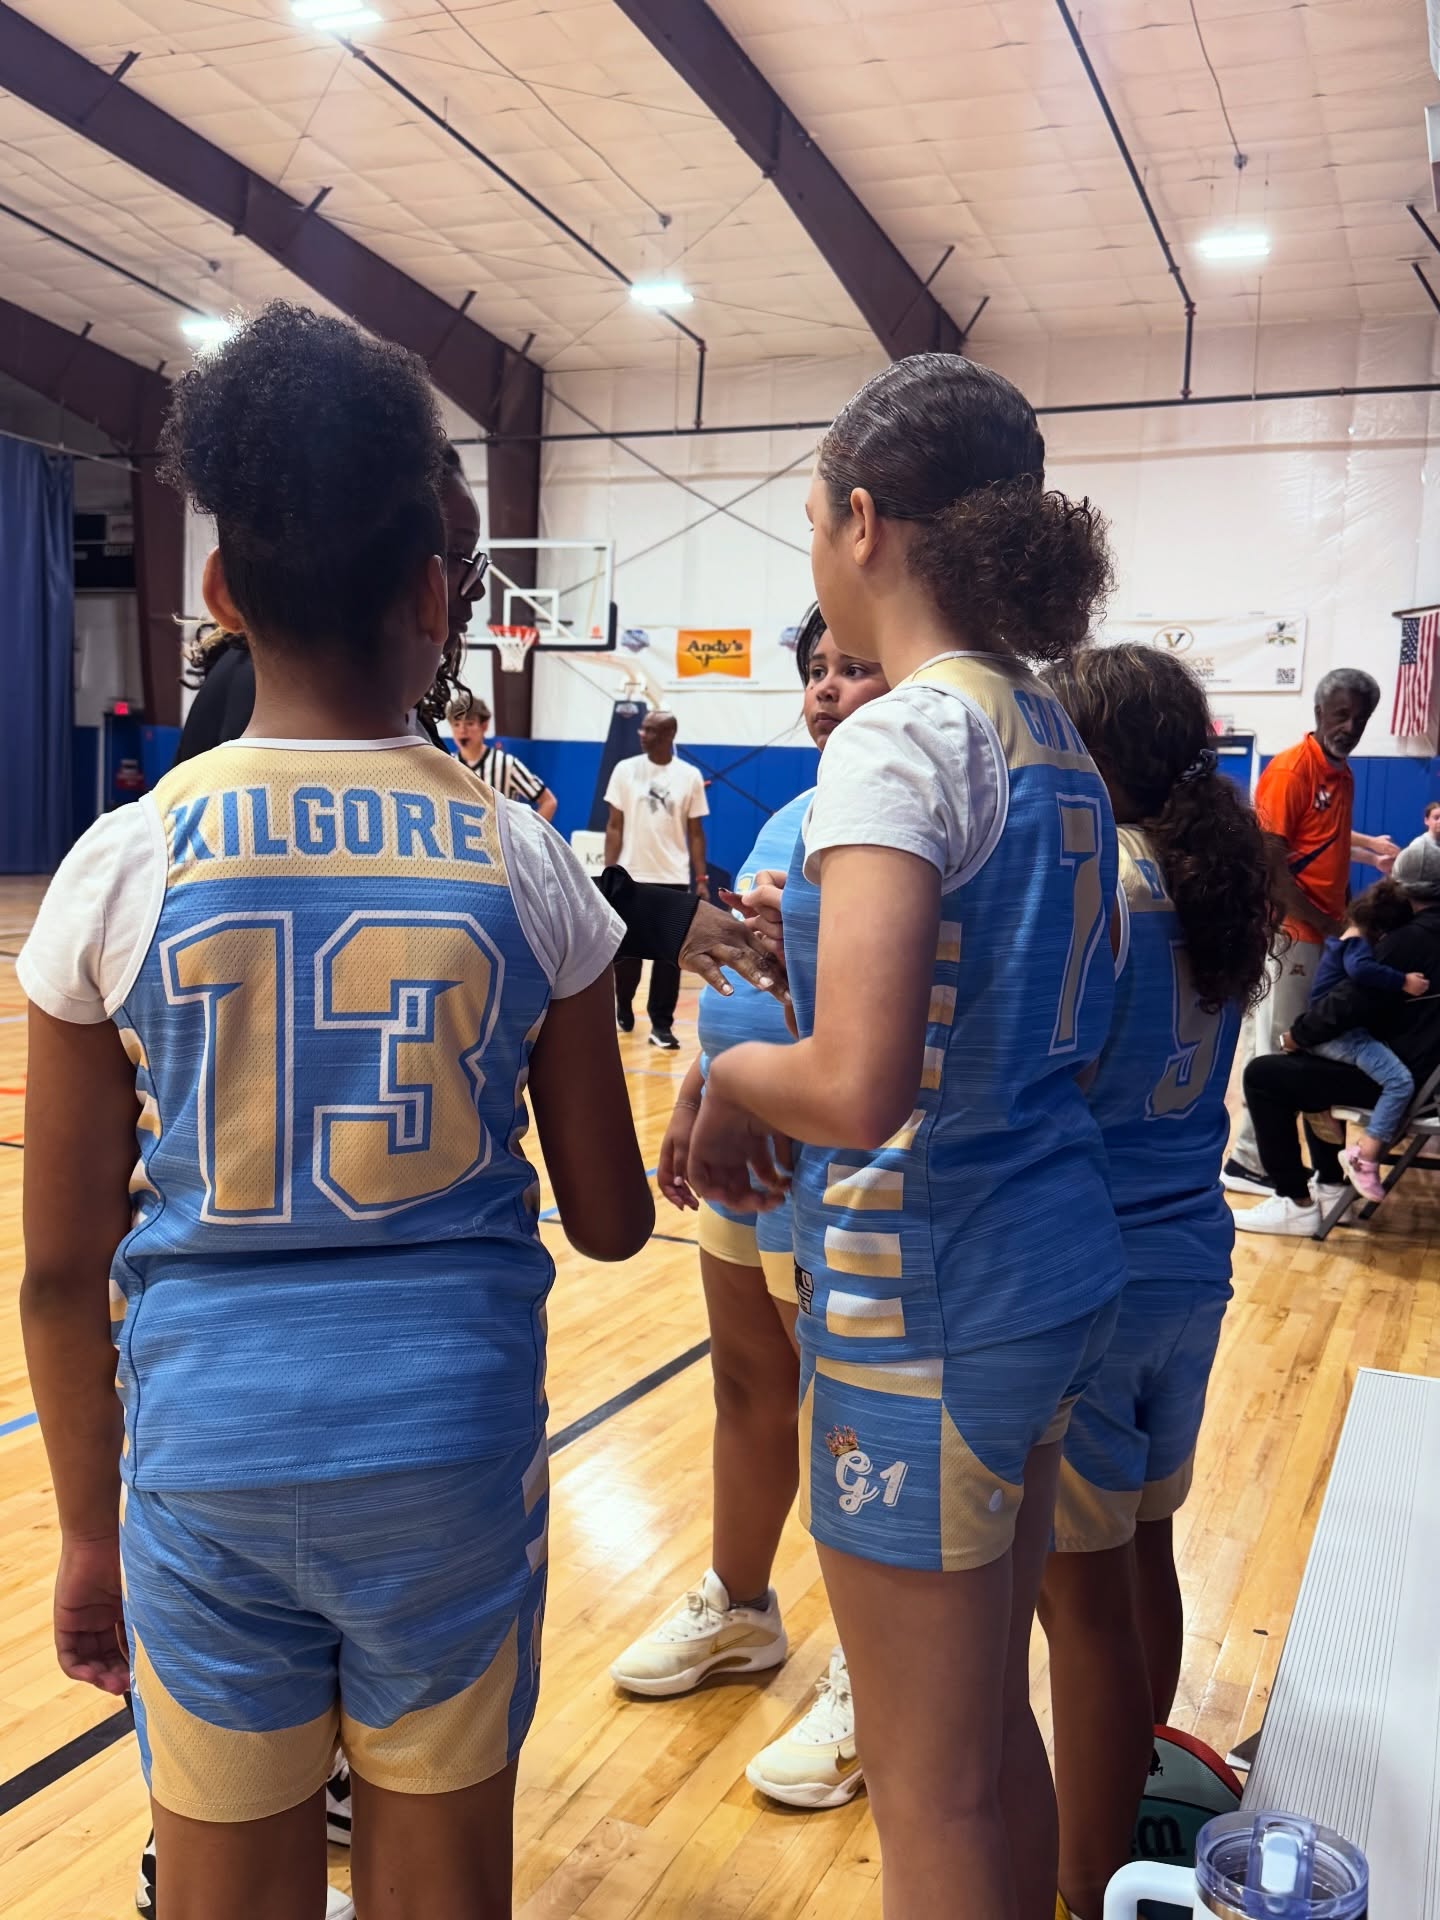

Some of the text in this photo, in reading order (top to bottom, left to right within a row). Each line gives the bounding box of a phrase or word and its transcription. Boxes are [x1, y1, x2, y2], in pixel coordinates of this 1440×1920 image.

[686, 639, 744, 654] Andy's
[168, 783, 499, 868] KILGORE
[1048, 793, 1106, 1056] 7
[159, 911, 506, 1224] 13
[835, 1449, 909, 1516] G1
